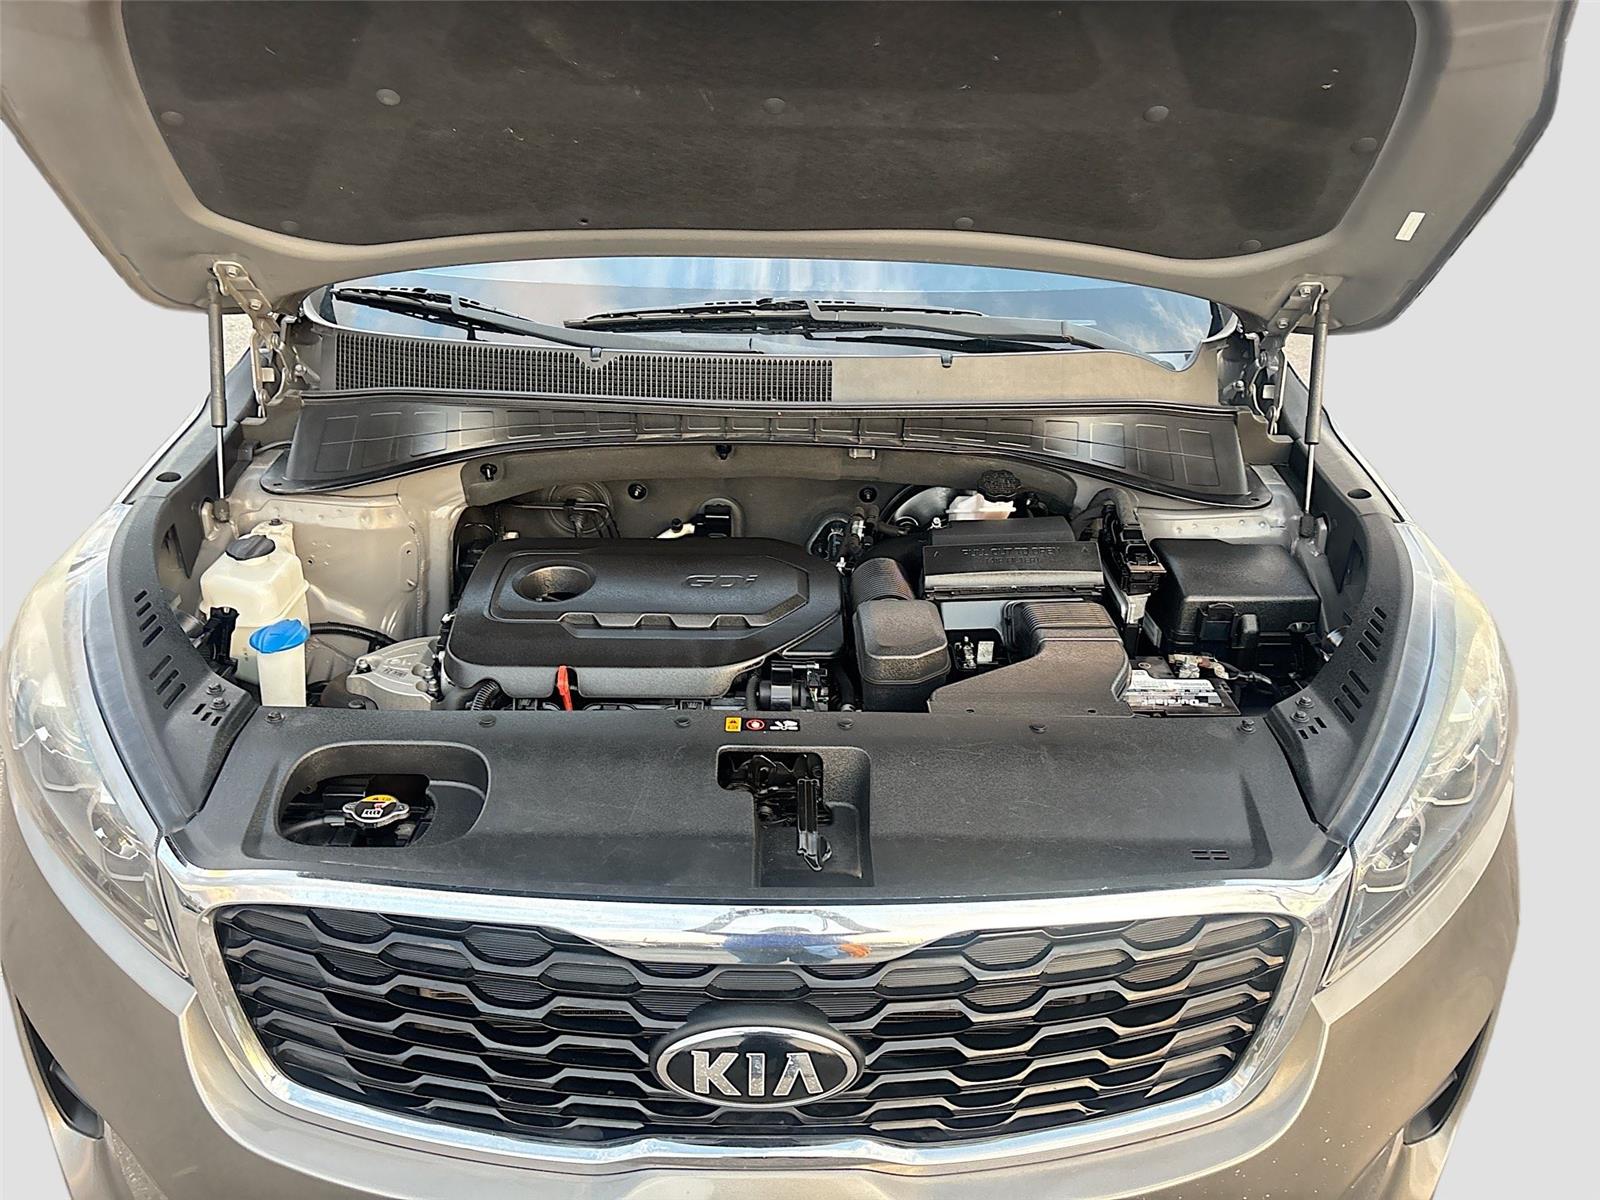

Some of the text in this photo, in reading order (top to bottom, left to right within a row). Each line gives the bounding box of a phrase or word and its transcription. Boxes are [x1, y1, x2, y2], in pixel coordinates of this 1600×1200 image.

[990, 547, 1013, 556] OUT
[1015, 547, 1029, 556] TO
[1031, 546, 1061, 556] OPEN
[691, 1050, 824, 1097] KIA
